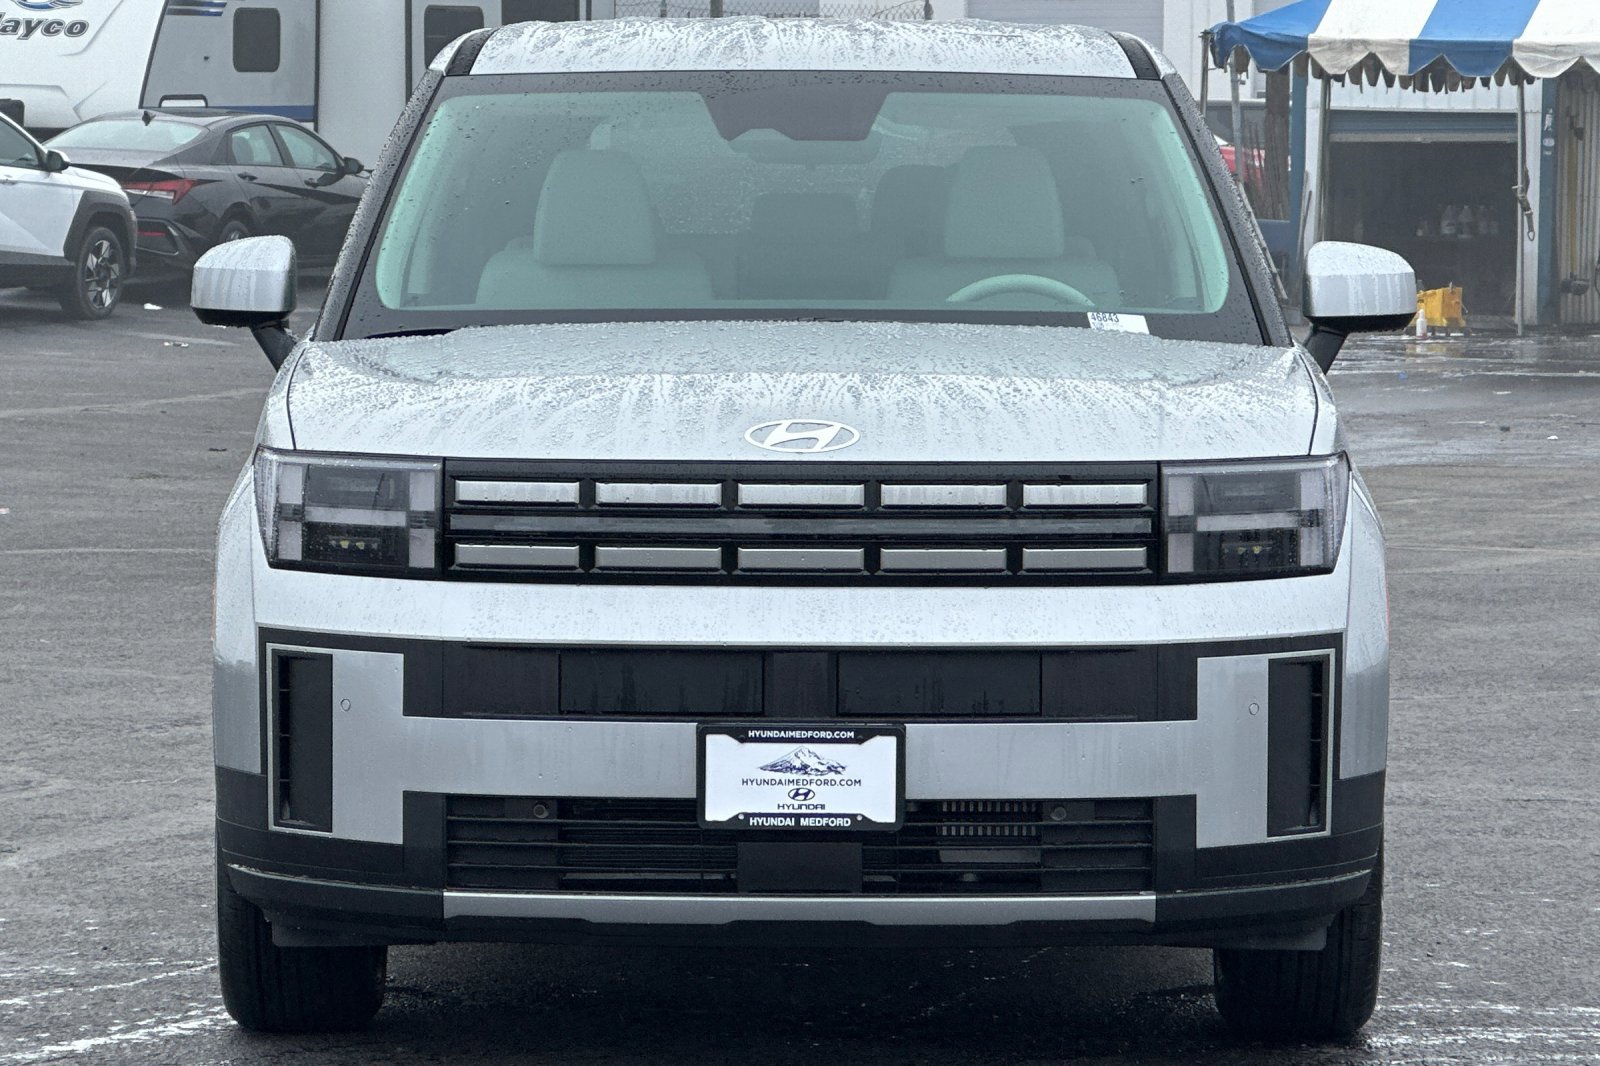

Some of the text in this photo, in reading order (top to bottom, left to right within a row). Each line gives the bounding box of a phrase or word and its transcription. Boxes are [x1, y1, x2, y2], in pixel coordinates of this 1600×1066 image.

[0, 12, 89, 40] ayco
[748, 730, 855, 739] HYUNDAIMEDFORD.COM
[741, 778, 862, 787] HYUNDAIMEDFORD.COM
[749, 817, 851, 827] HYUNDAI MEDFORD
